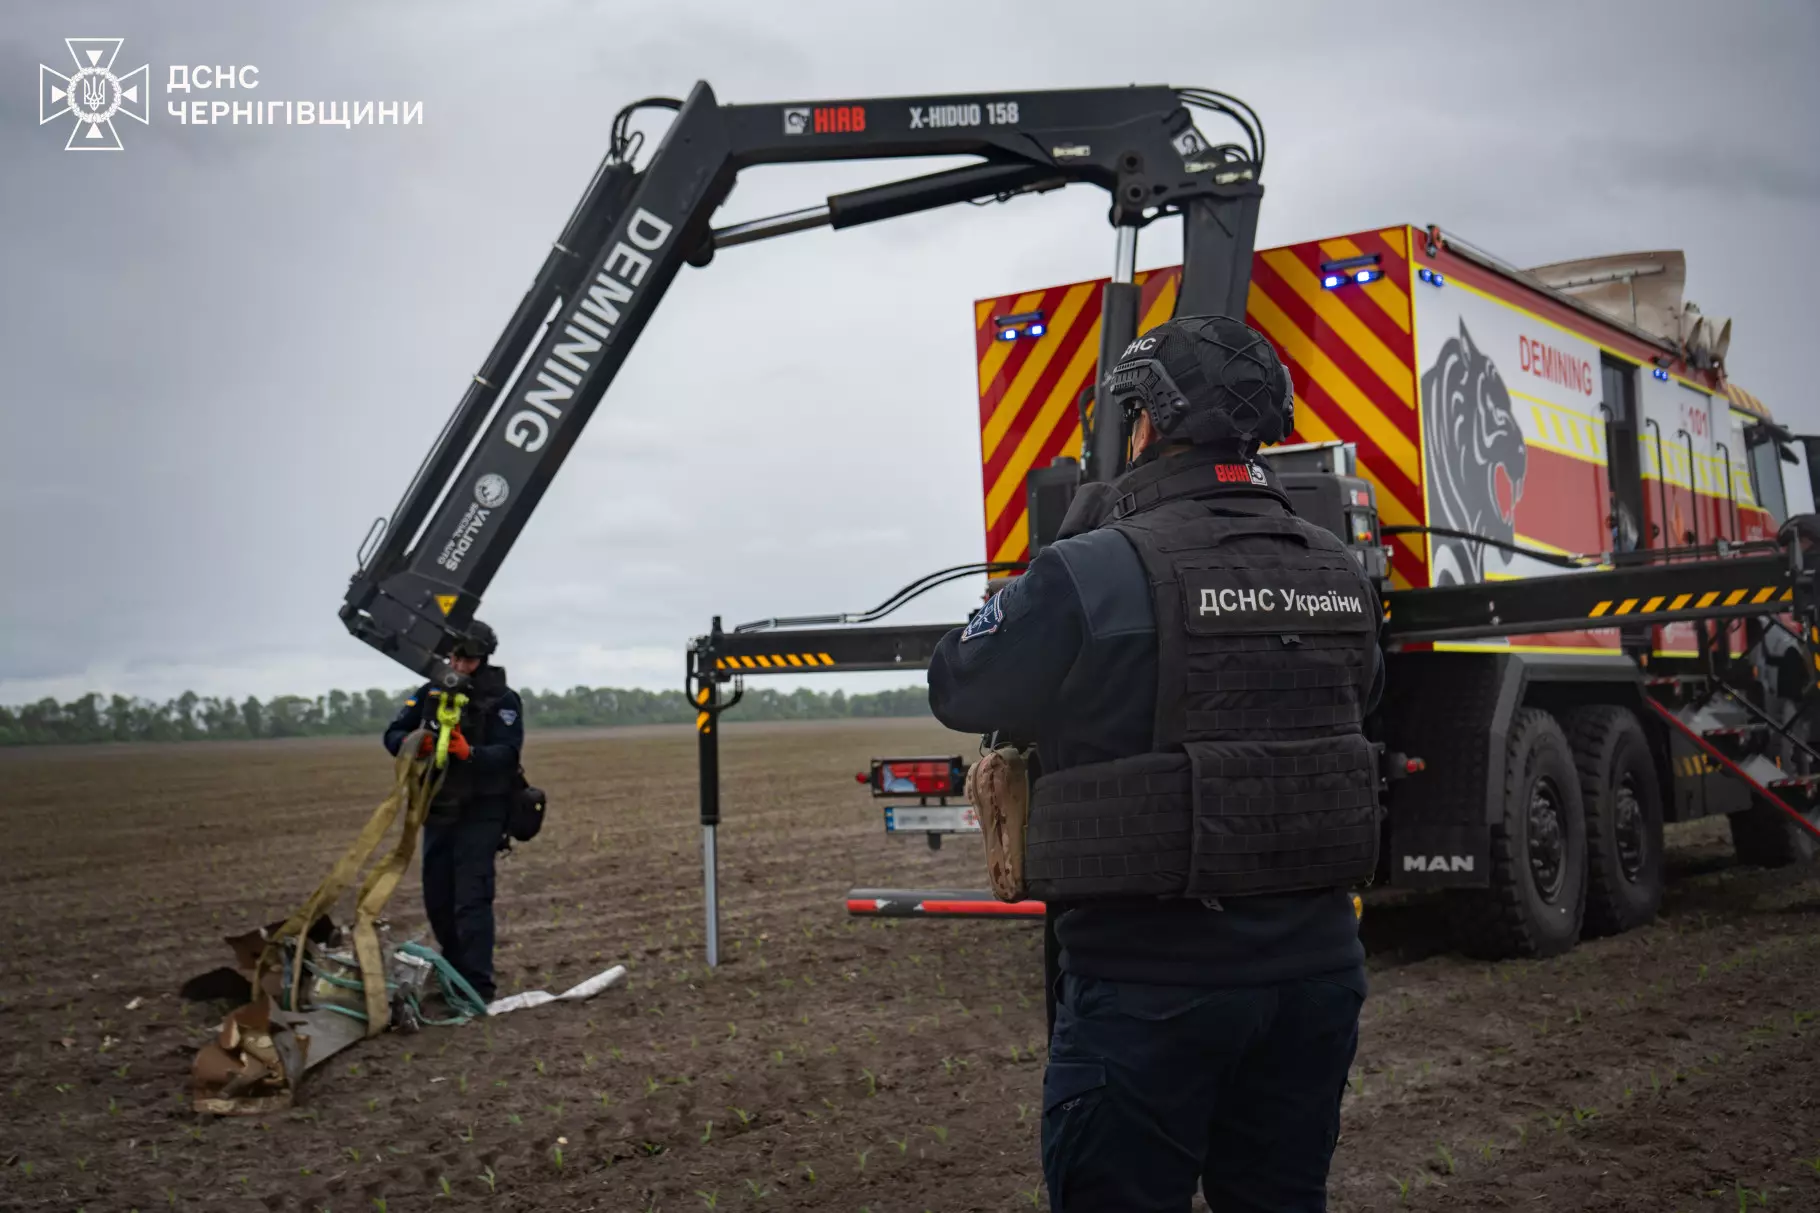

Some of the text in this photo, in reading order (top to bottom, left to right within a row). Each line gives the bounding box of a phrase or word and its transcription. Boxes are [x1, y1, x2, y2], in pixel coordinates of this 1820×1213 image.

[814, 107, 866, 134] HIAB
[909, 102, 1019, 129] X-HIDUO 158
[505, 207, 673, 452] DEMINING
[1519, 335, 1593, 397] DEMINING
[1214, 463, 1250, 483] HIAB
[445, 508, 491, 571] VALIDUS
[1200, 588, 1362, 616] ДСНС України
[1403, 855, 1474, 872] MAN
